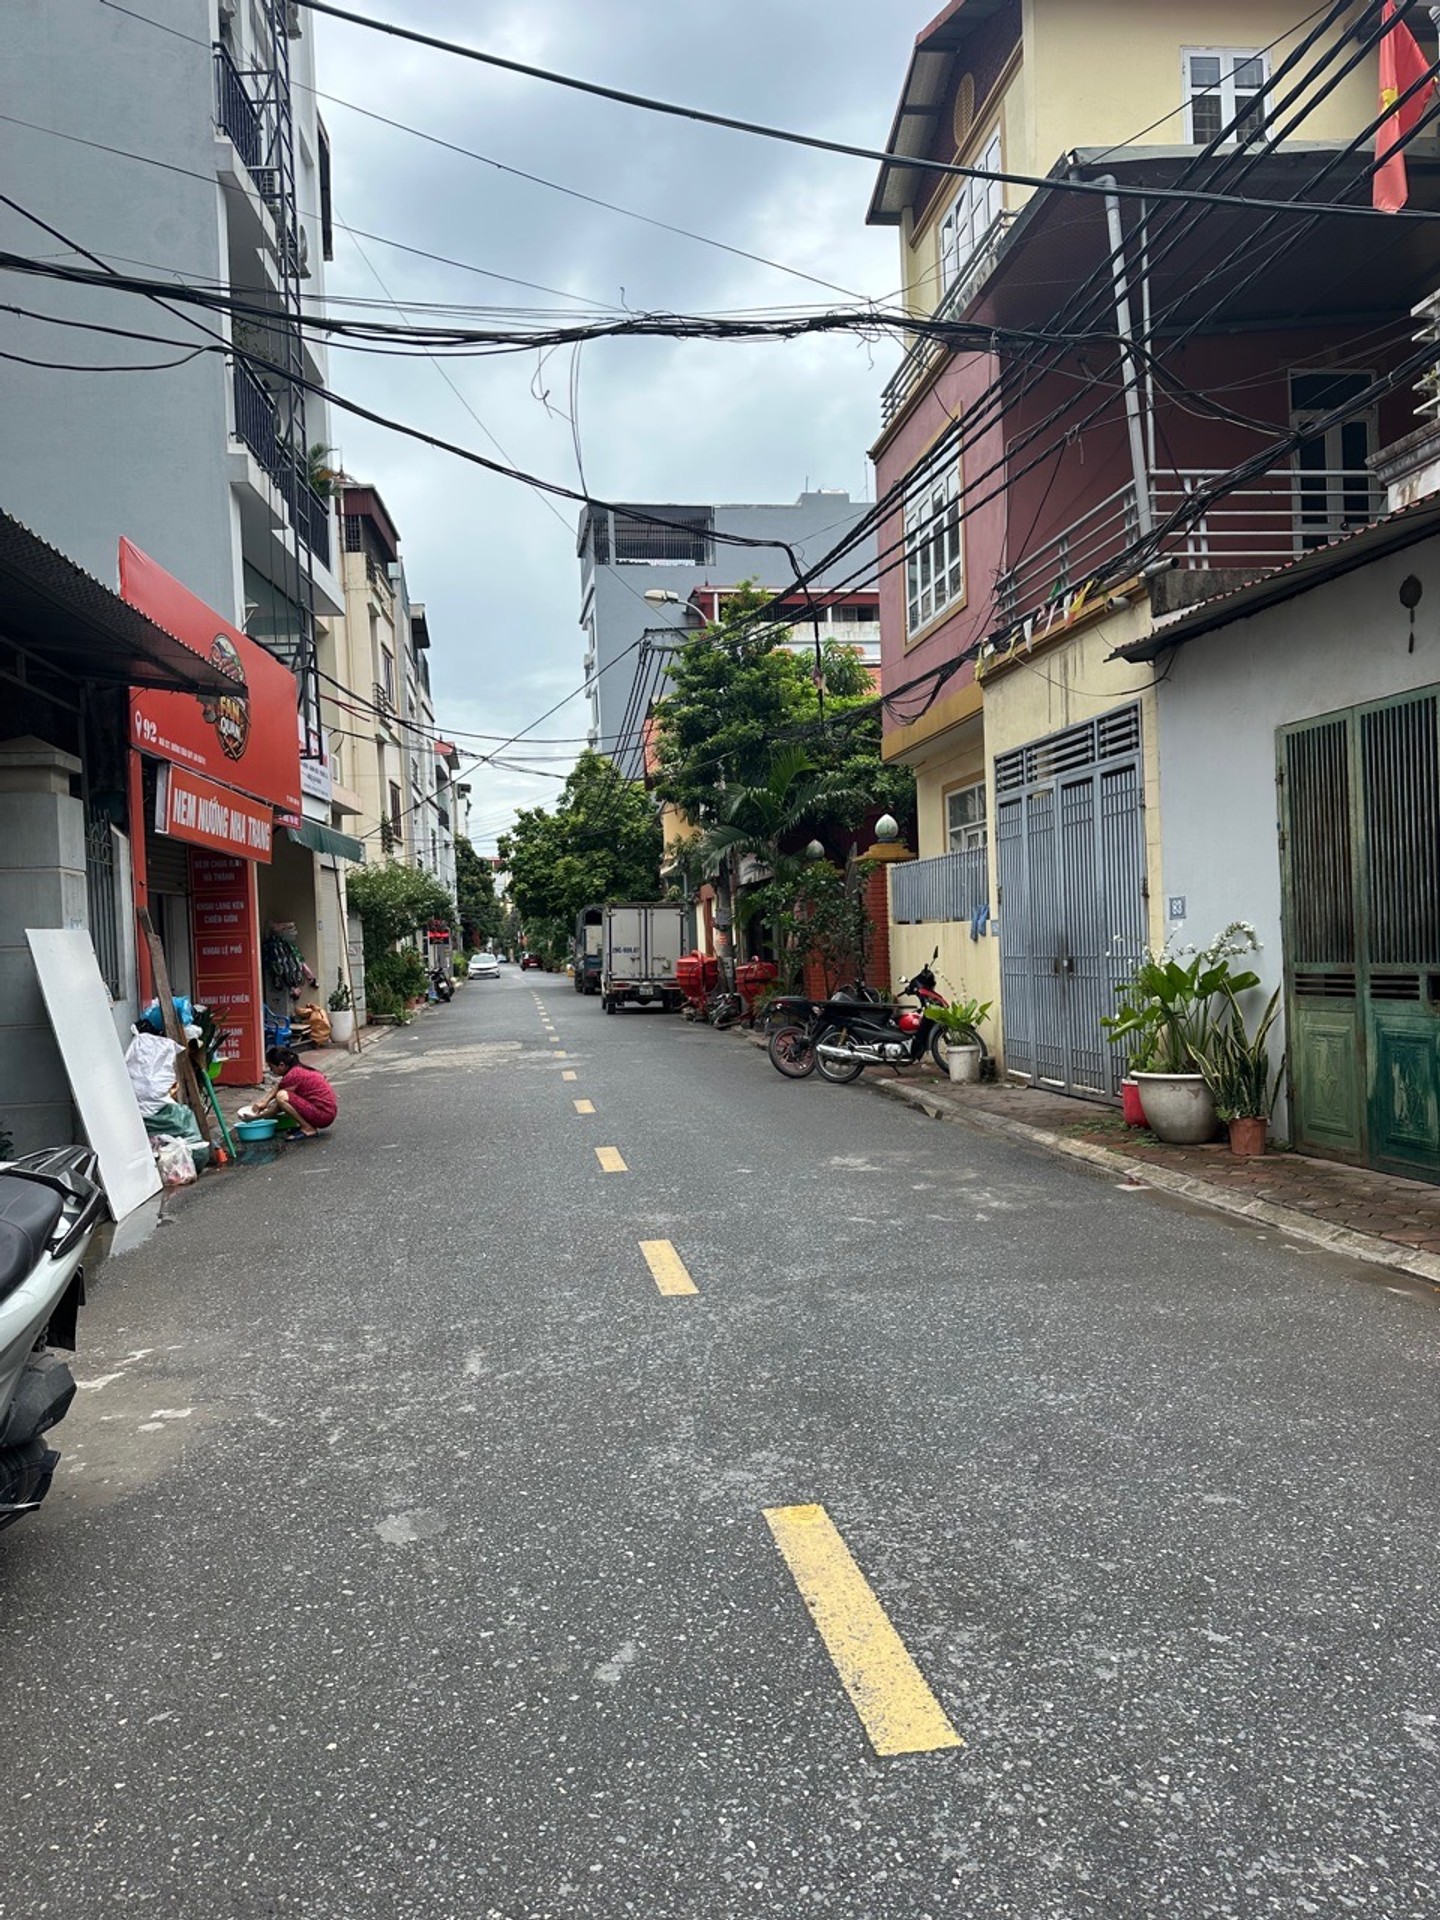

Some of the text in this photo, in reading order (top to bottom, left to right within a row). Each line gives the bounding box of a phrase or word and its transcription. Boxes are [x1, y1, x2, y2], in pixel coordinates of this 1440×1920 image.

[143, 718, 157, 743] 92
[173, 788, 270, 851] NEM NƯỚNG NHA TRANG
[1171, 899, 1182, 914] 83
[203, 946, 220, 955] KHOAI
[201, 996, 218, 1005] KHOAI
